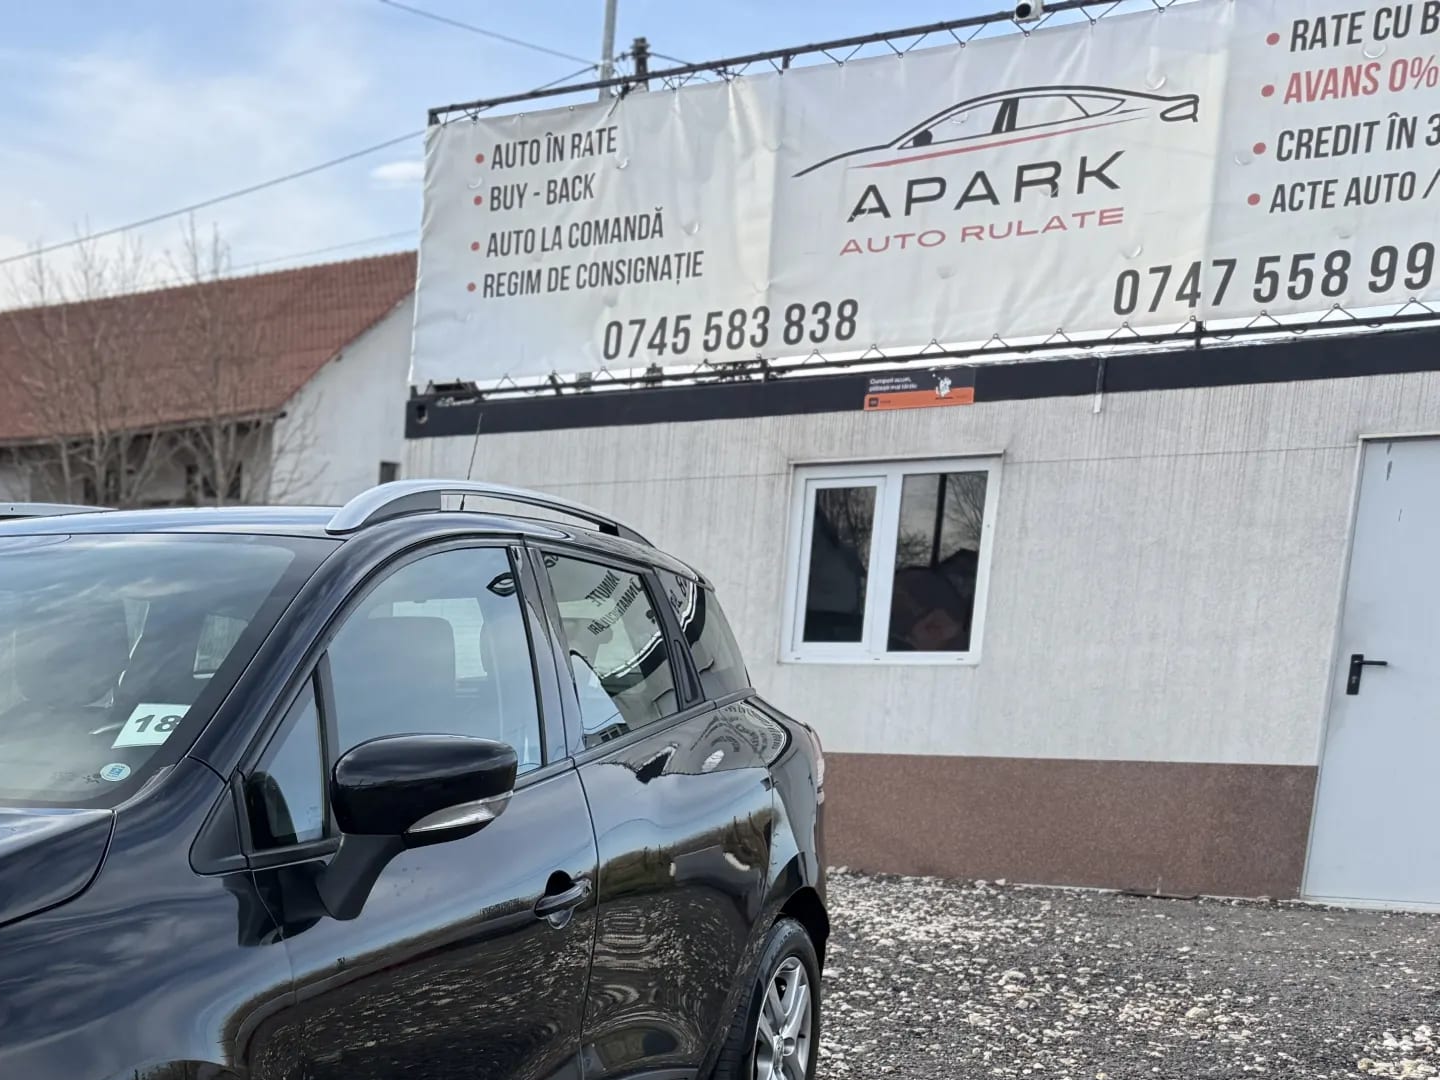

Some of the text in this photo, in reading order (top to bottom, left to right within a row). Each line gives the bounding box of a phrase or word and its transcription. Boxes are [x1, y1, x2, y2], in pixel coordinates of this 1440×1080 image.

[1290, 10, 1366, 53] RATE
[1373, 4, 1413, 41] CU
[1283, 55, 1439, 105] AVANS 0%
[491, 126, 618, 171] AUTO ÎN RATE
[1276, 120, 1381, 162] CREDIT
[1386, 112, 1418, 151] ÎN
[489, 183, 528, 213] BUY
[546, 173, 596, 205] BACK
[847, 150, 1126, 223] APARK
[1269, 178, 1338, 214] ACTE
[1343, 171, 1416, 208] AUTO
[486, 207, 664, 259] AUTO LA COMANDĂ
[839, 207, 1125, 257] AUTO RULATE
[482, 250, 704, 299] REGIM DE CONSIGNAȚIE
[1113, 242, 1436, 316] 0747 558 99
[603, 299, 860, 361] 0745 583 838
